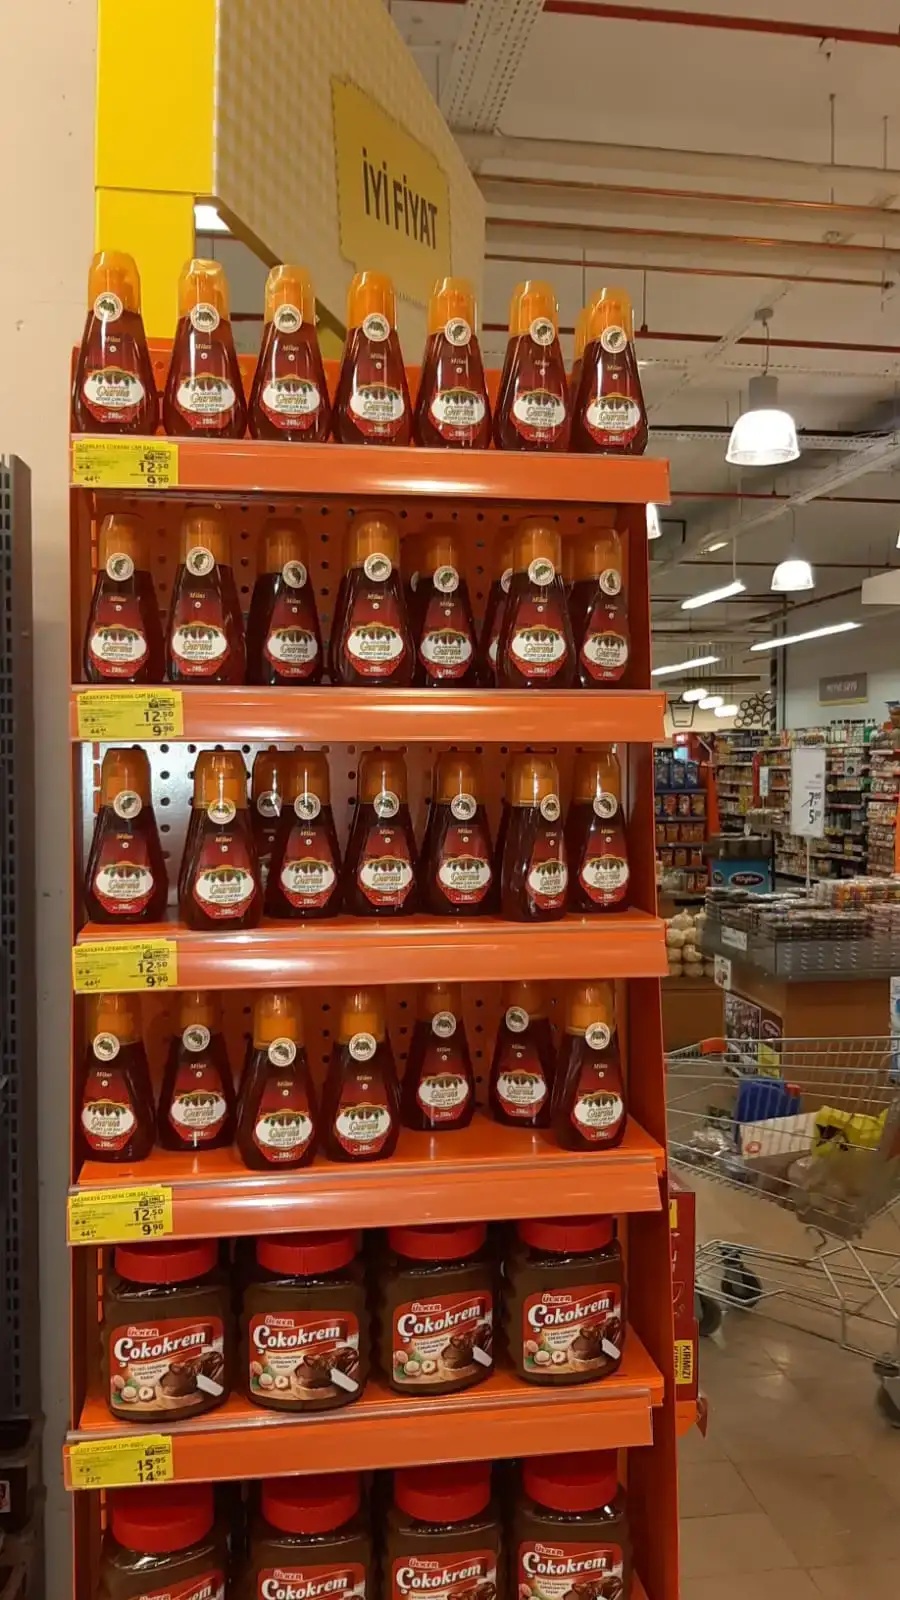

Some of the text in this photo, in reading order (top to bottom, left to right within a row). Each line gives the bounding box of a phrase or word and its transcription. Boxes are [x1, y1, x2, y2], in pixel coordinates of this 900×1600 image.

[362, 146, 438, 250] İYİ FİYAT
[398, 1304, 480, 1343] Çokokrem
[528, 1297, 610, 1332] Çokokrem
[114, 1331, 206, 1368] Çokokrem
[253, 1326, 340, 1354] Çokokrem
[682, 1345, 691, 1379] KIRMIZI
[396, 1562, 481, 1594] Çokokrem
[522, 1551, 607, 1578] Çokokrem
